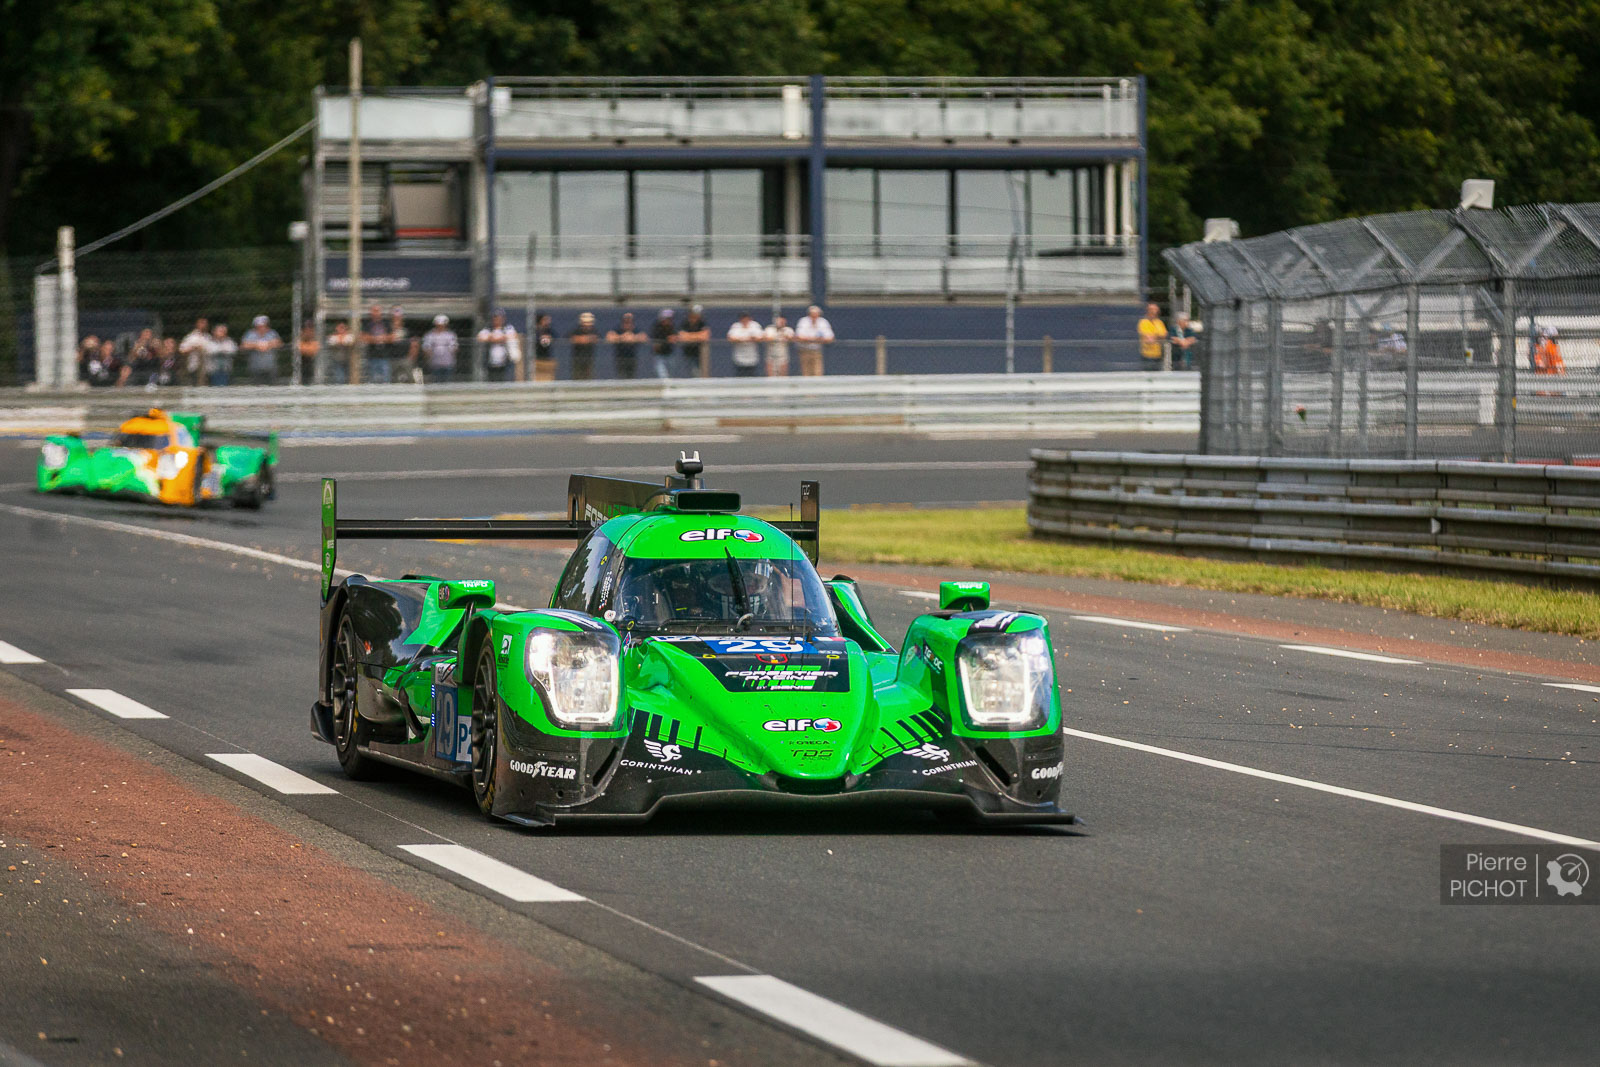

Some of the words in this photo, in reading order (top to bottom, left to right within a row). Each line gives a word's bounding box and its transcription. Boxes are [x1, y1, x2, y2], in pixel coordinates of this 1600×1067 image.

[679, 527, 733, 542] elf
[718, 640, 804, 653] 29
[762, 719, 812, 732] elf
[509, 759, 577, 780] GOODYEAR
[620, 759, 693, 776] CORINTHIAN
[922, 759, 978, 776] CORINTHIAN
